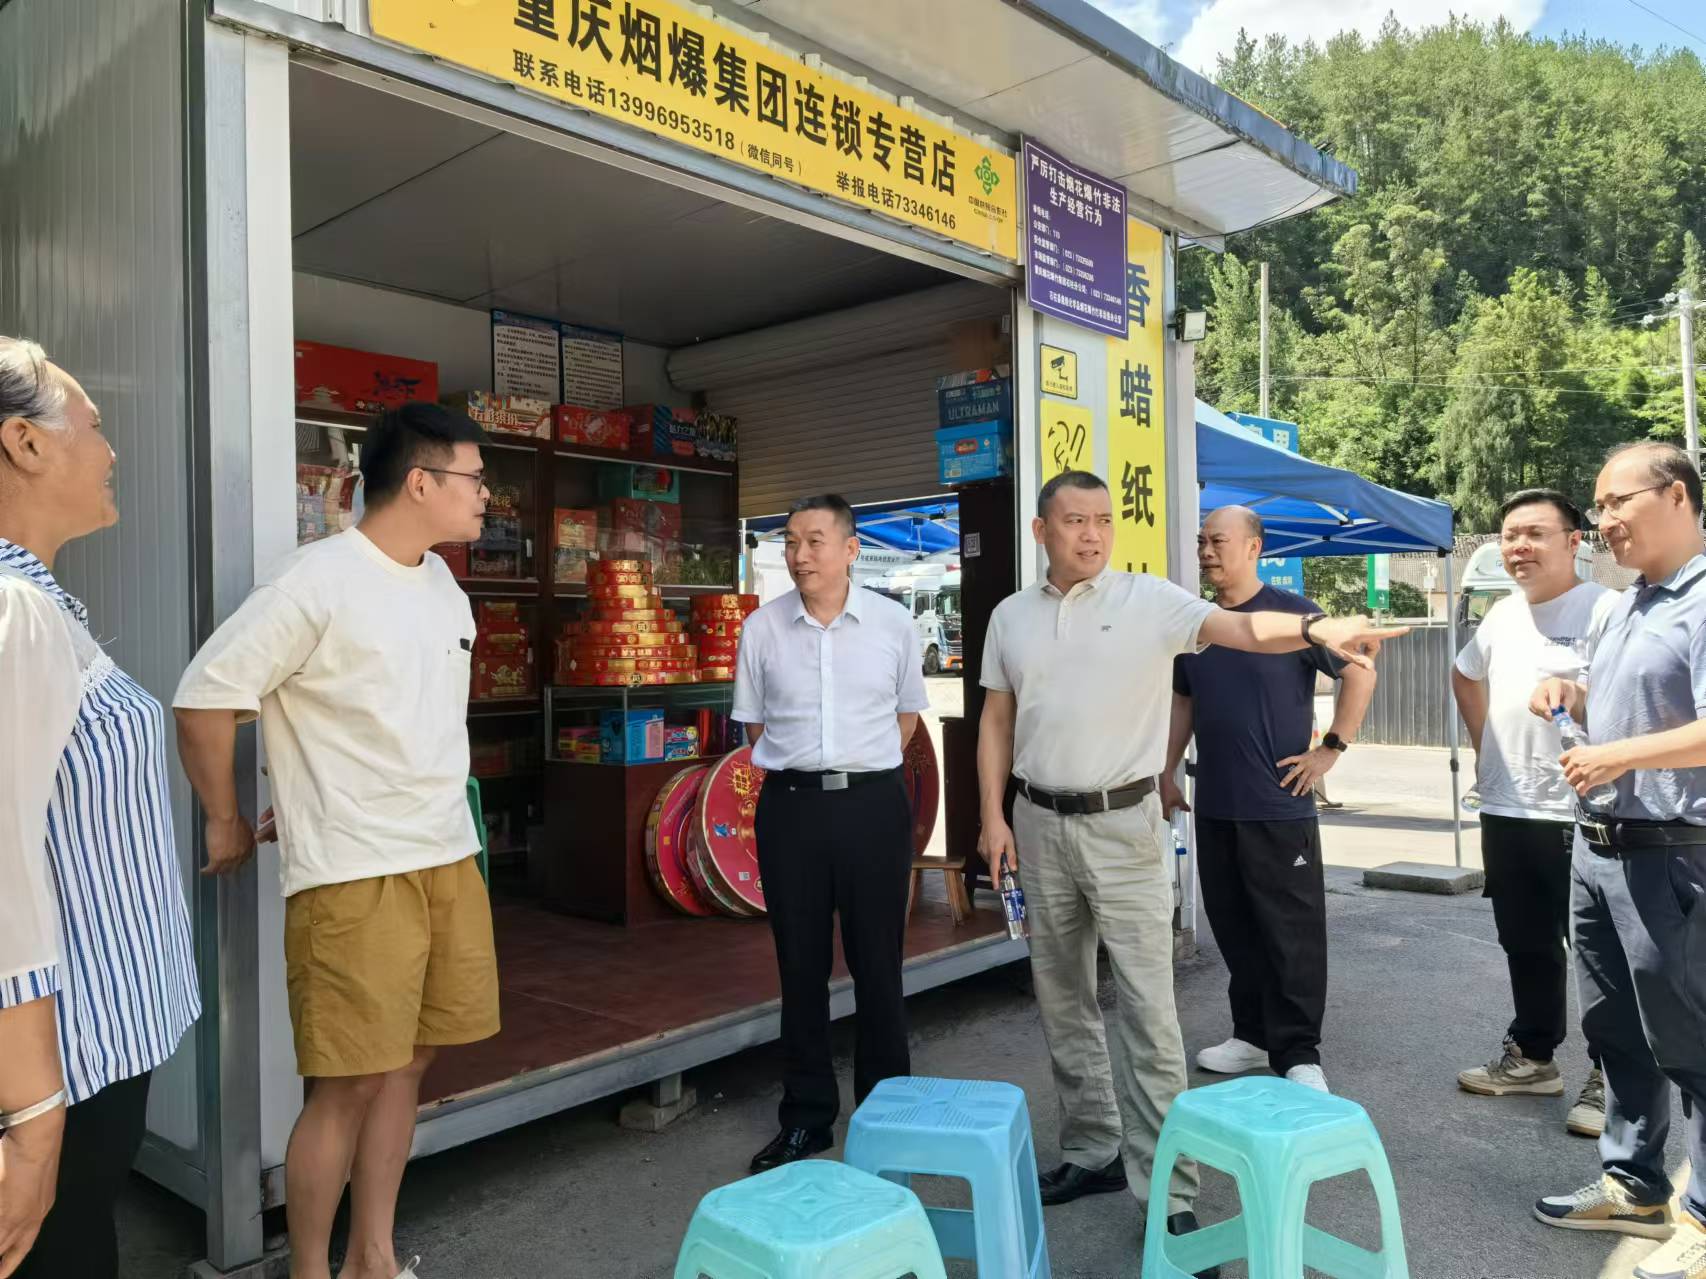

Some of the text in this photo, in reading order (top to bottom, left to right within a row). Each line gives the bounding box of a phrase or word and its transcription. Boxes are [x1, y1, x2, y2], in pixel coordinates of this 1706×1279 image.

[512, 48, 735, 151] 联系电话13996953518
[836, 170, 957, 230] 举报电话73346146
[513, 0, 956, 197] 重庆烟爆集团连锁专营店
[1030, 153, 1121, 214] 严厉打击烟花爆竹非法
[1049, 187, 1103, 227] 生产经营行为
[948, 399, 1000, 420] ULTRAMAN
[1119, 262, 1155, 573] 香蜡纸
